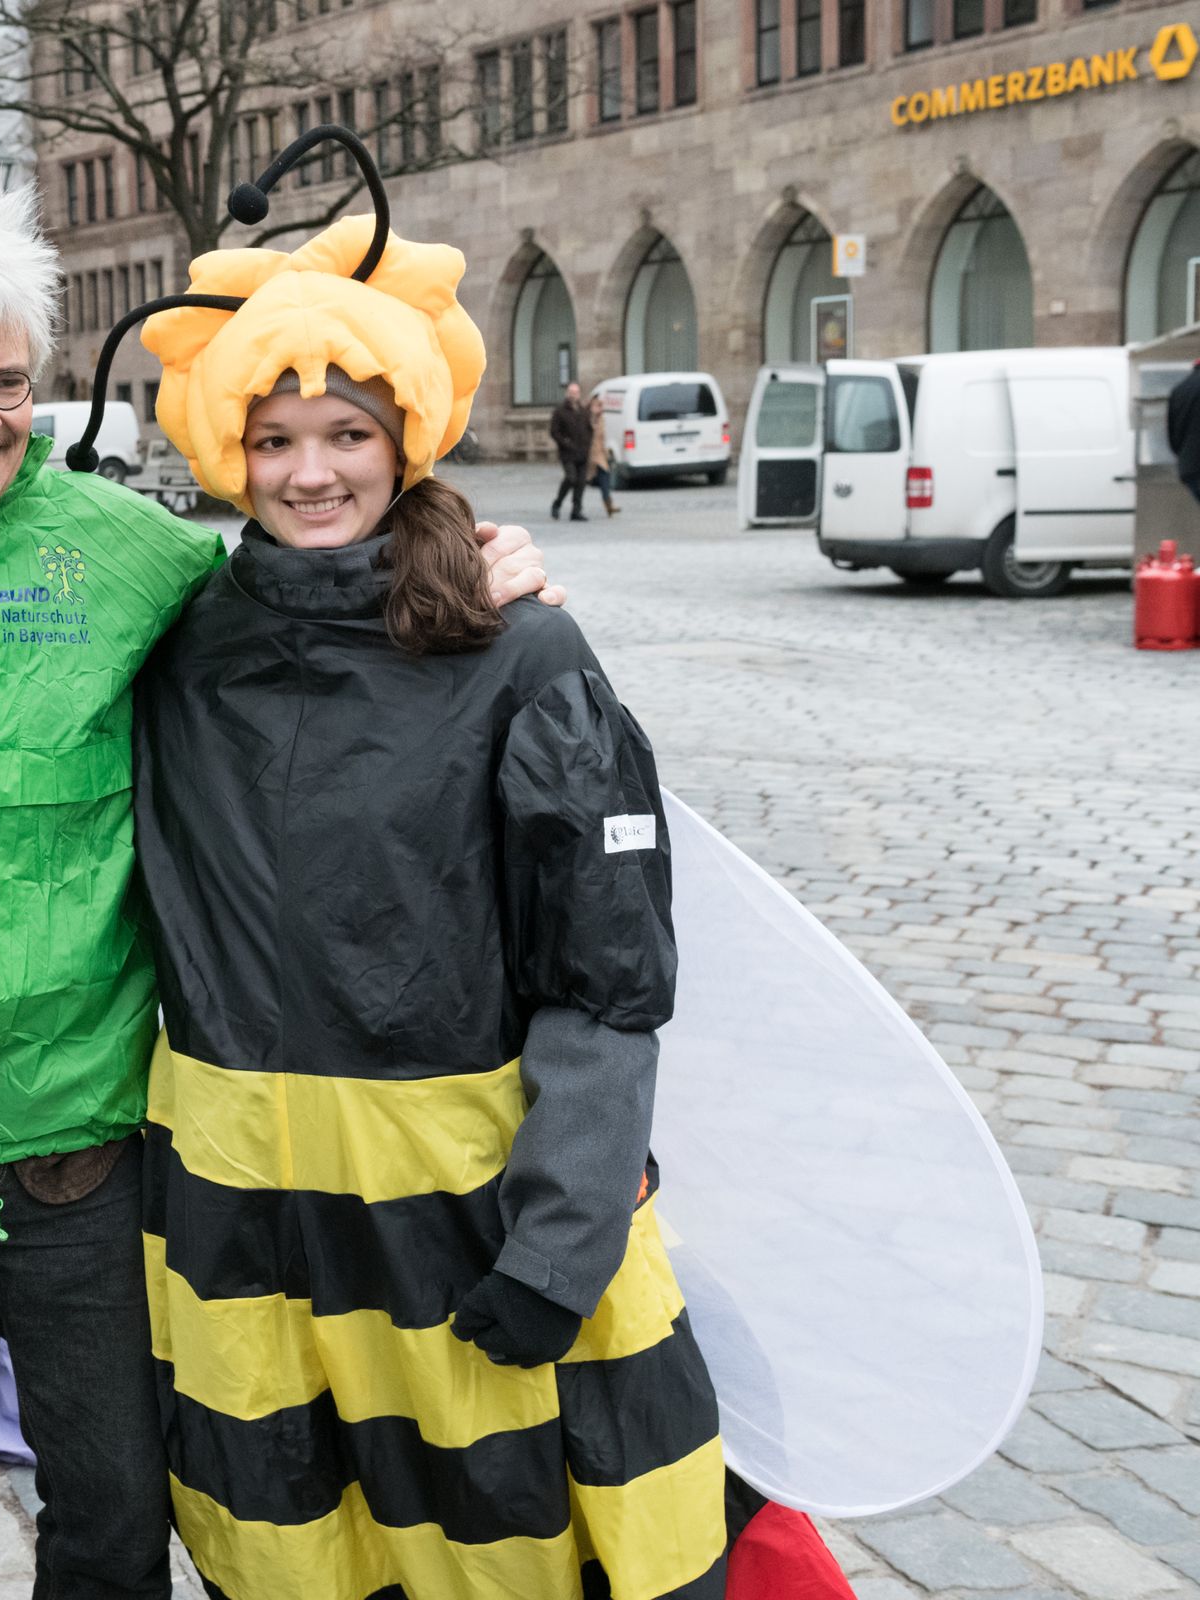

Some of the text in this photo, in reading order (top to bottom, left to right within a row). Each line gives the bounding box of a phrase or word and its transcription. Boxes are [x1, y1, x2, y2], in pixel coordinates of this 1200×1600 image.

[890, 47, 1138, 126] COMMERZBANK
[0, 587, 50, 602] BUND
[2, 609, 87, 624] Naturschutz
[3, 628, 91, 645] in Bayern e.V.
